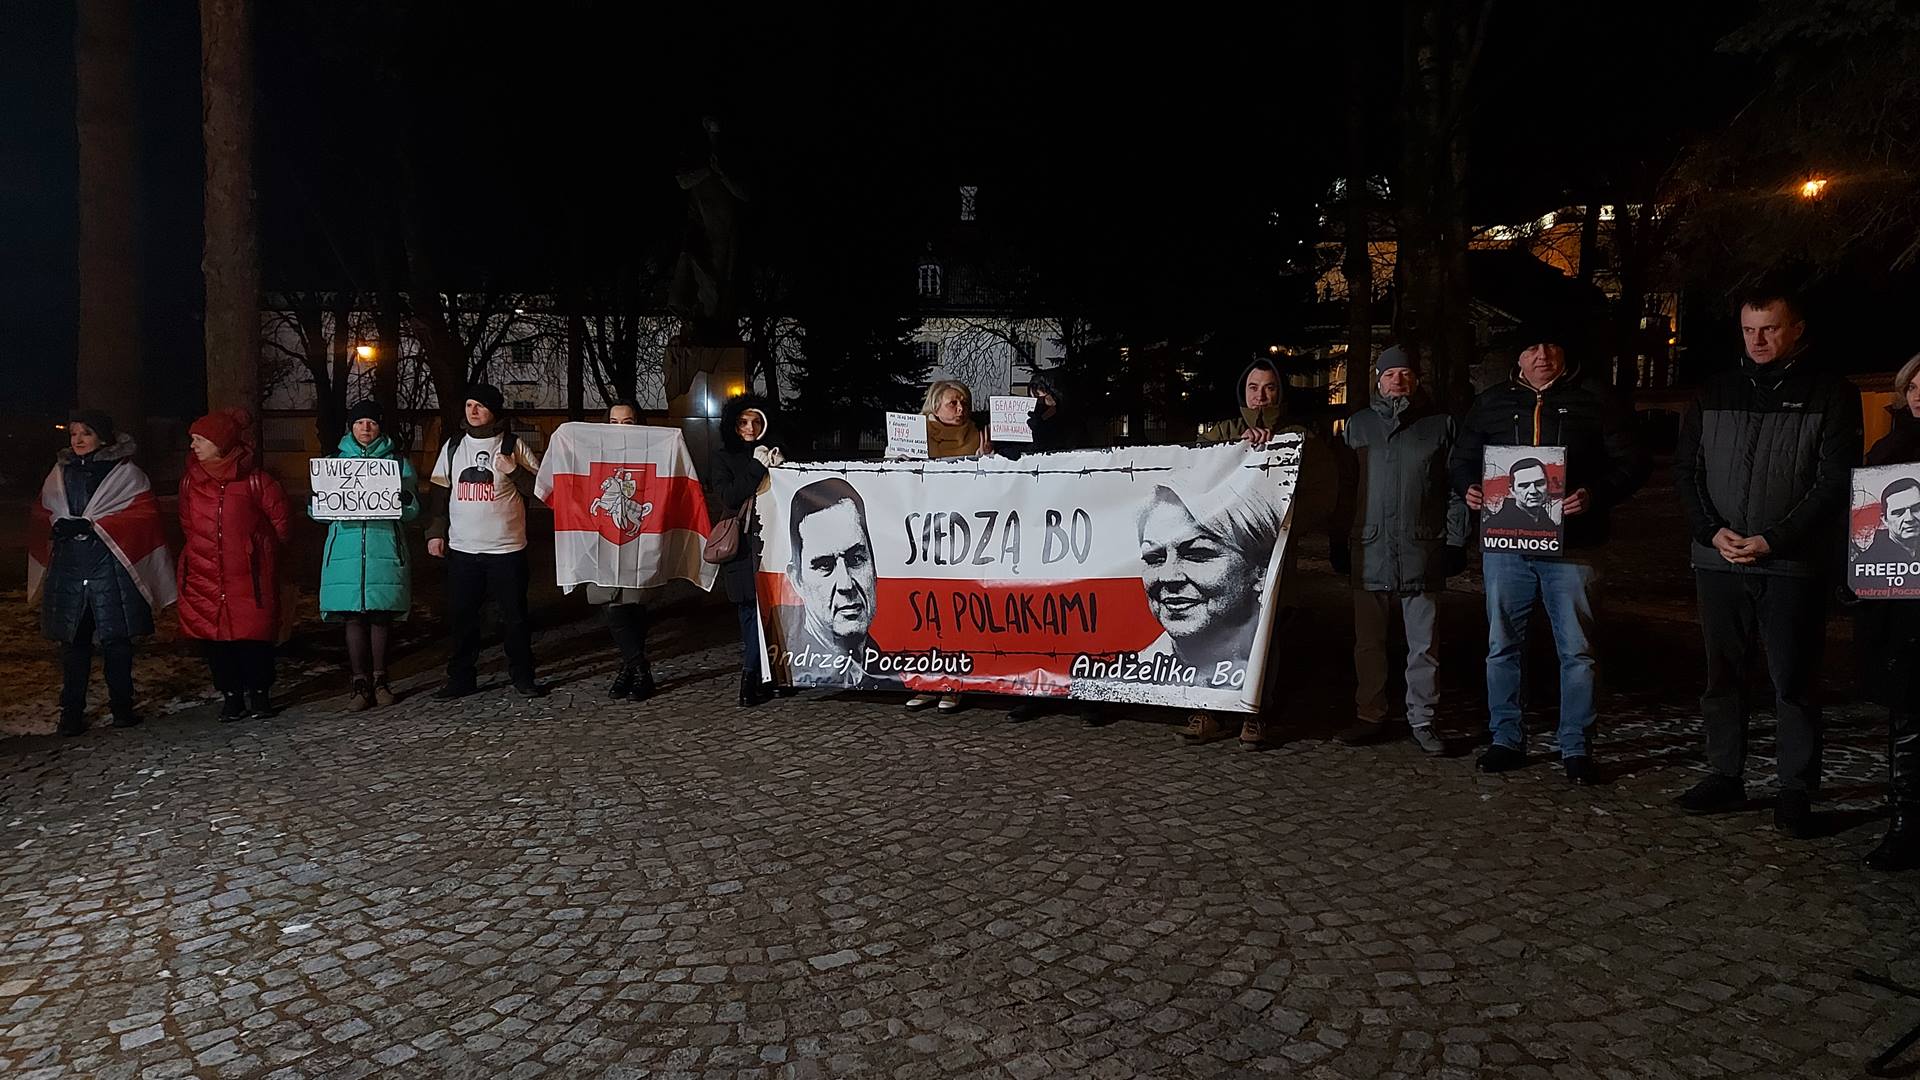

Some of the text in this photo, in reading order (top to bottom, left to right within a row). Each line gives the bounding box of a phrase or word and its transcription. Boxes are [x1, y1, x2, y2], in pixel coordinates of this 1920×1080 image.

[1004, 412, 1017, 424] SOS
[339, 476, 364, 489] ZA
[905, 508, 1092, 575] SIEDZĄ BO
[1483, 537, 1560, 551] WOLNOŚĆ
[1886, 576, 1904, 587] TO
[908, 591, 1097, 639] SĄ POLAKAMI
[766, 644, 972, 675] Andrzej Poczobut
[1072, 653, 1197, 684] Andżelika
